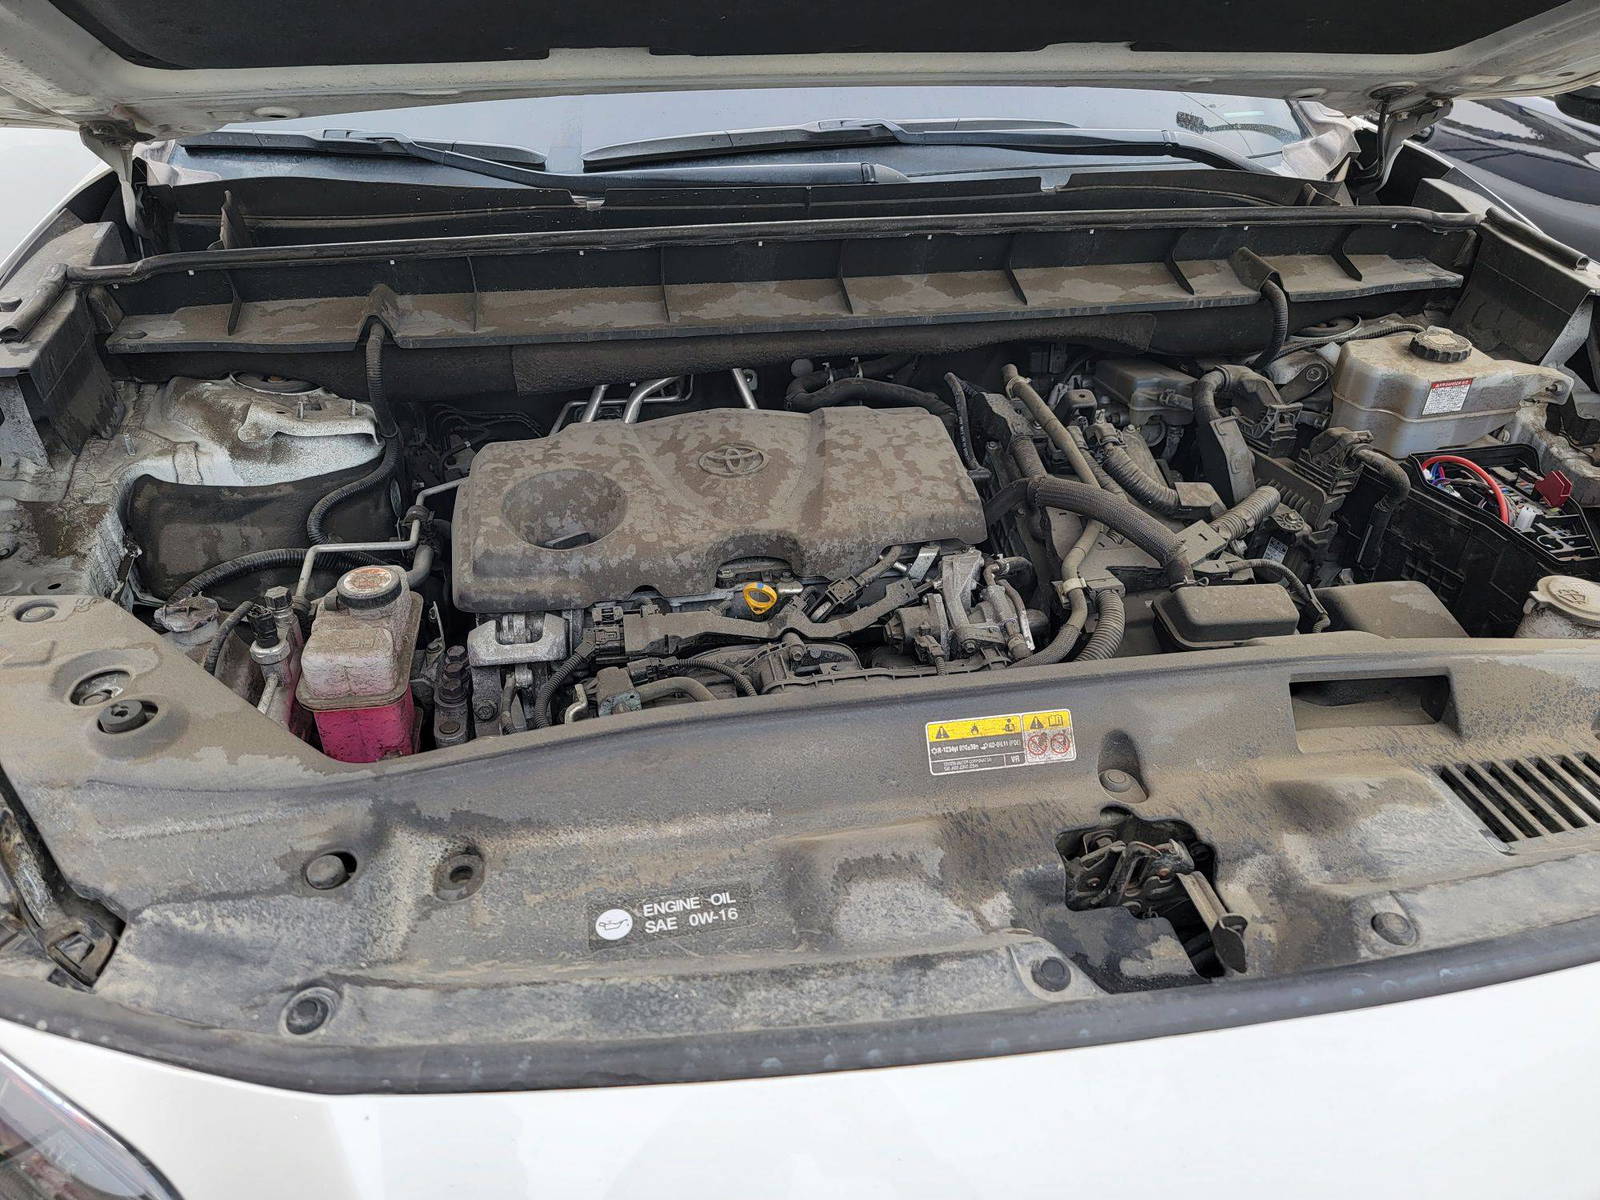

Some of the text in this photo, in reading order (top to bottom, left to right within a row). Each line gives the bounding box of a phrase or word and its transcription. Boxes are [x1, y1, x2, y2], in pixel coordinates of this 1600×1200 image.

[642, 892, 736, 916] ENGINE OIL
[644, 907, 738, 933] SAE 0W-16
